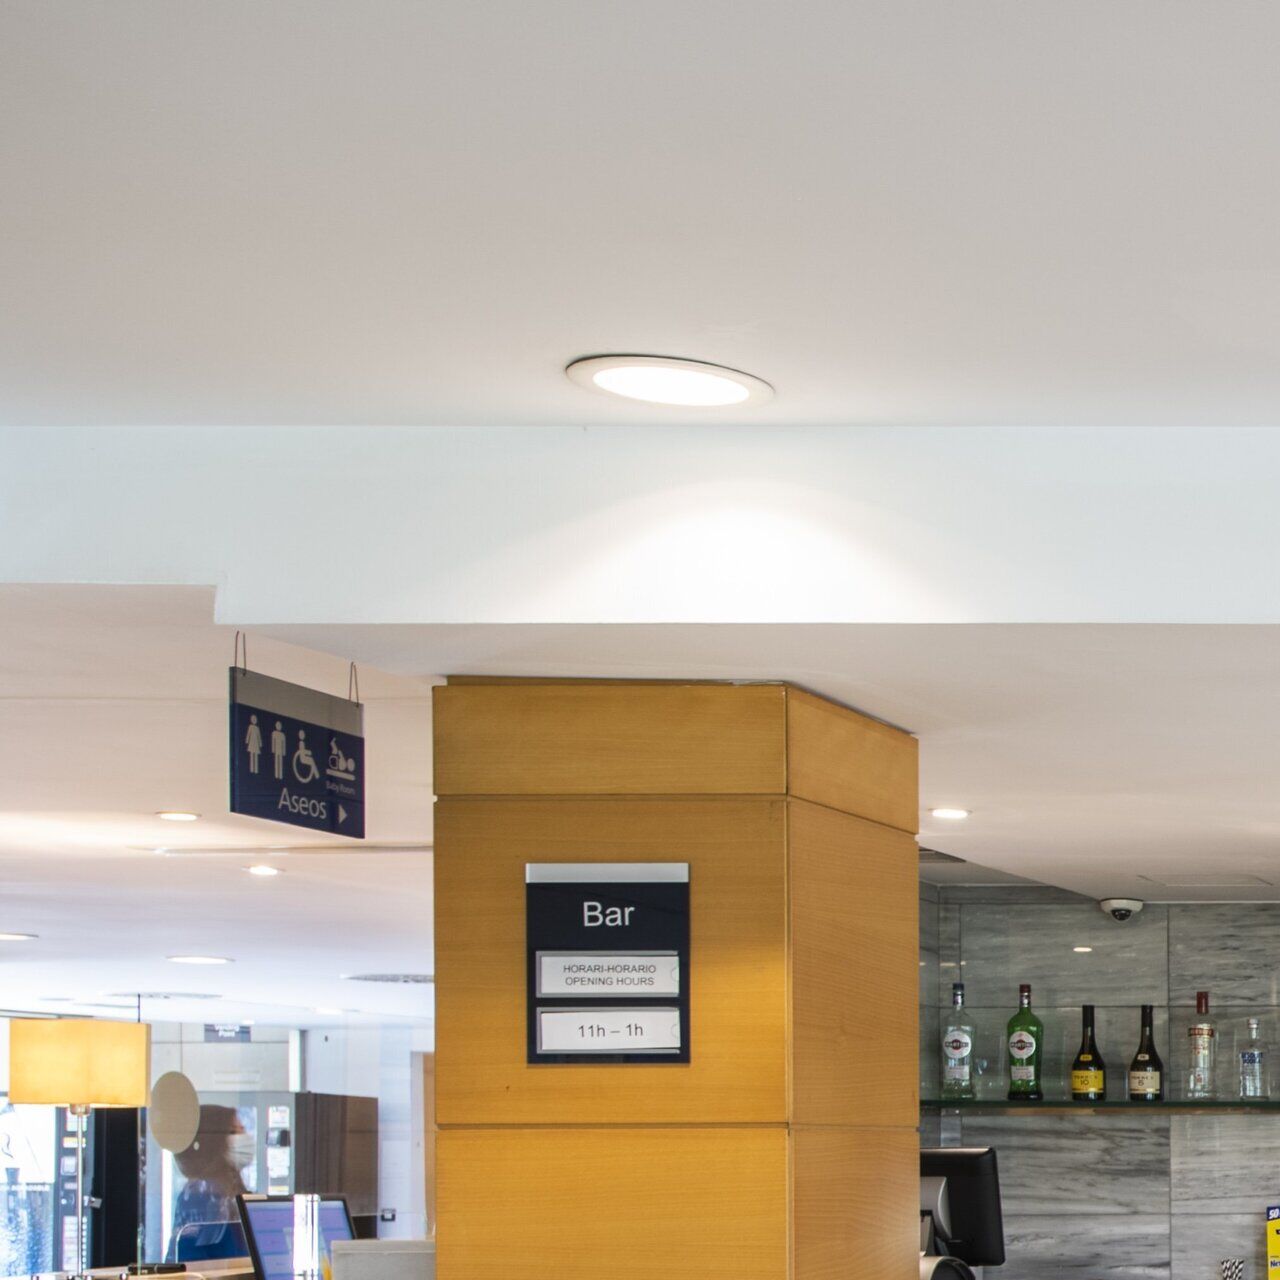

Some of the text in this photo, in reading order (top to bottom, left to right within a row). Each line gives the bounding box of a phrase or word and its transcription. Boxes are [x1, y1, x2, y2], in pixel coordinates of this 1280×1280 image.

[278, 787, 327, 819] Aseos
[583, 901, 635, 927] Bar
[563, 964, 656, 974] HORARI-HORARIO
[565, 977, 655, 986] OPENING HOURS
[579, 1024, 606, 1037] 11h
[626, 1023, 644, 1037] 1h
